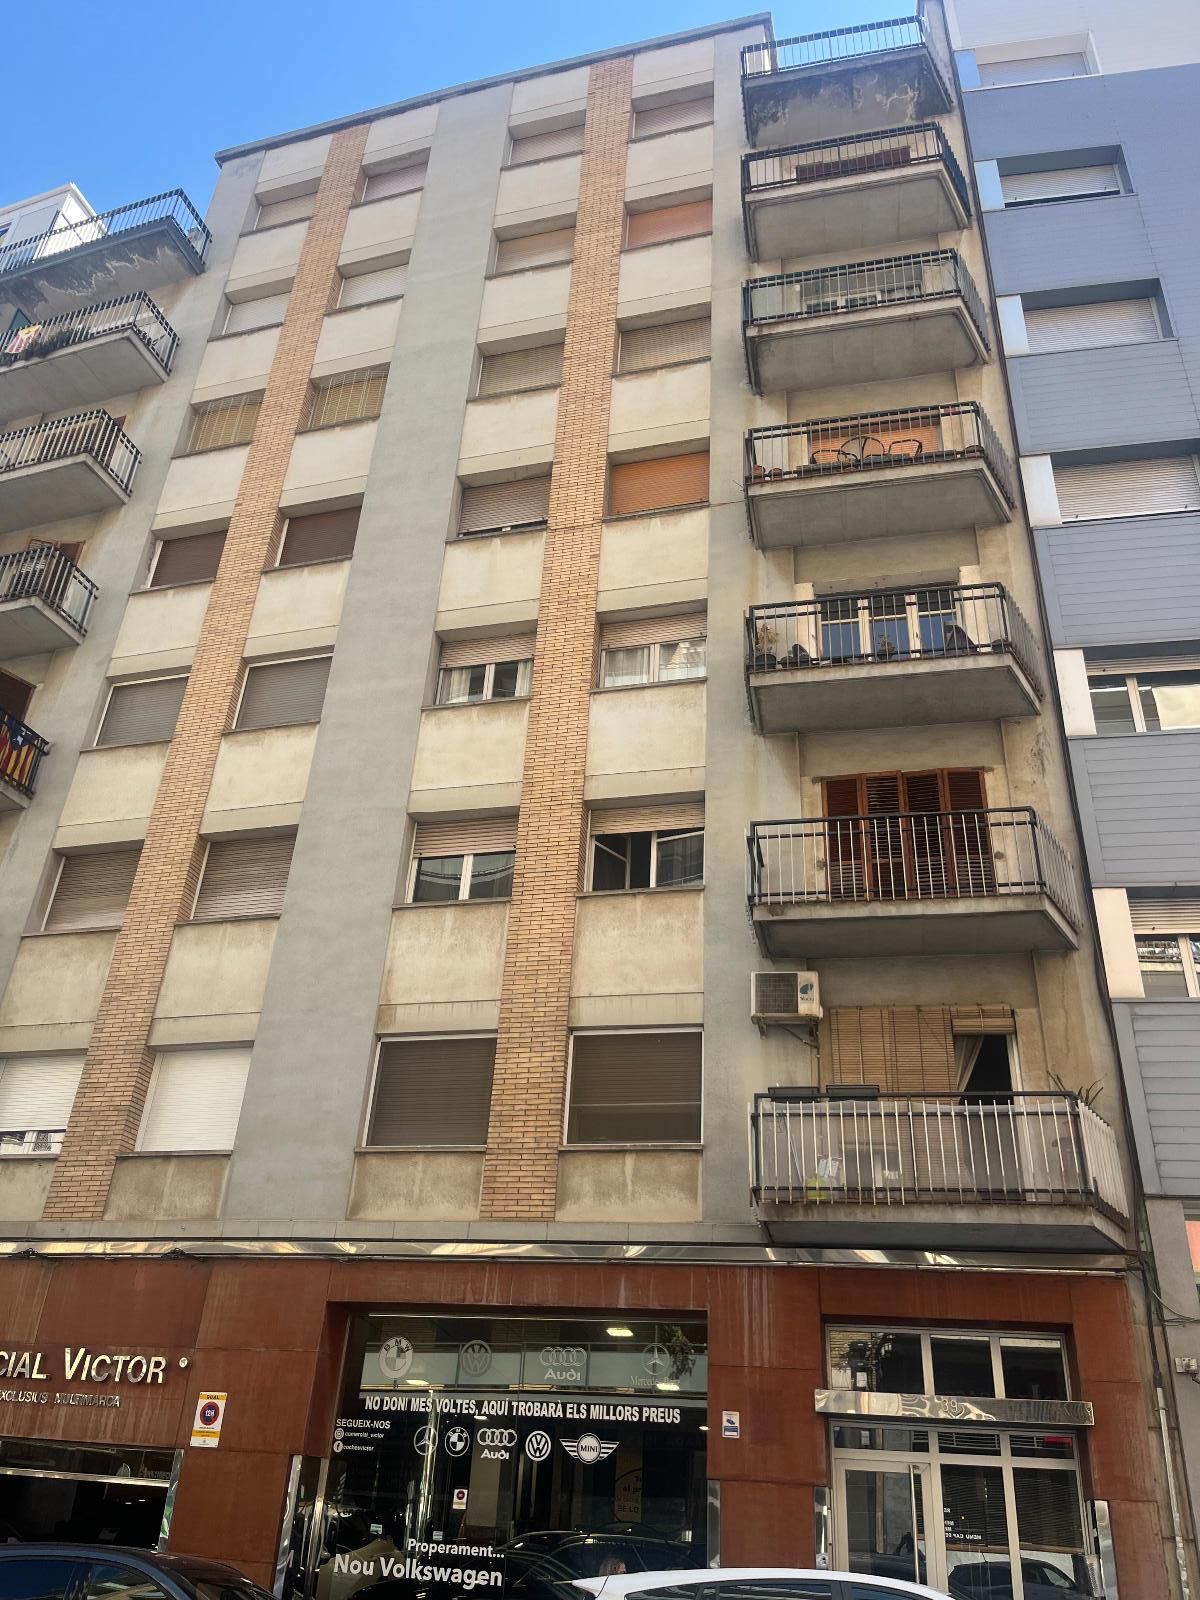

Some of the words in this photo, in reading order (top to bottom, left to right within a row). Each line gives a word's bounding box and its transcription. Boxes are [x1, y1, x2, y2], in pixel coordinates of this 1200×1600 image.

[543, 1368, 581, 1380] Audi
[364, 1396, 380, 1411] NO
[436, 1398, 479, 1415] VOLTES,
[481, 1398, 510, 1416] AQUÍ
[512, 1400, 564, 1418] TROBARÀ
[566, 1403, 587, 1419] ELS
[589, 1404, 640, 1421] MILLORS
[642, 1407, 681, 1423] PREUS
[942, 1399, 958, 1413] 39
[335, 1418, 391, 1429] SEGUEIX-NOS
[480, 1448, 510, 1460] Audi
[580, 1444, 598, 1453] MINI
[407, 1537, 505, 1559] Properament...
[333, 1553, 374, 1576] Nou
[379, 1556, 503, 1590] Volkswagen
